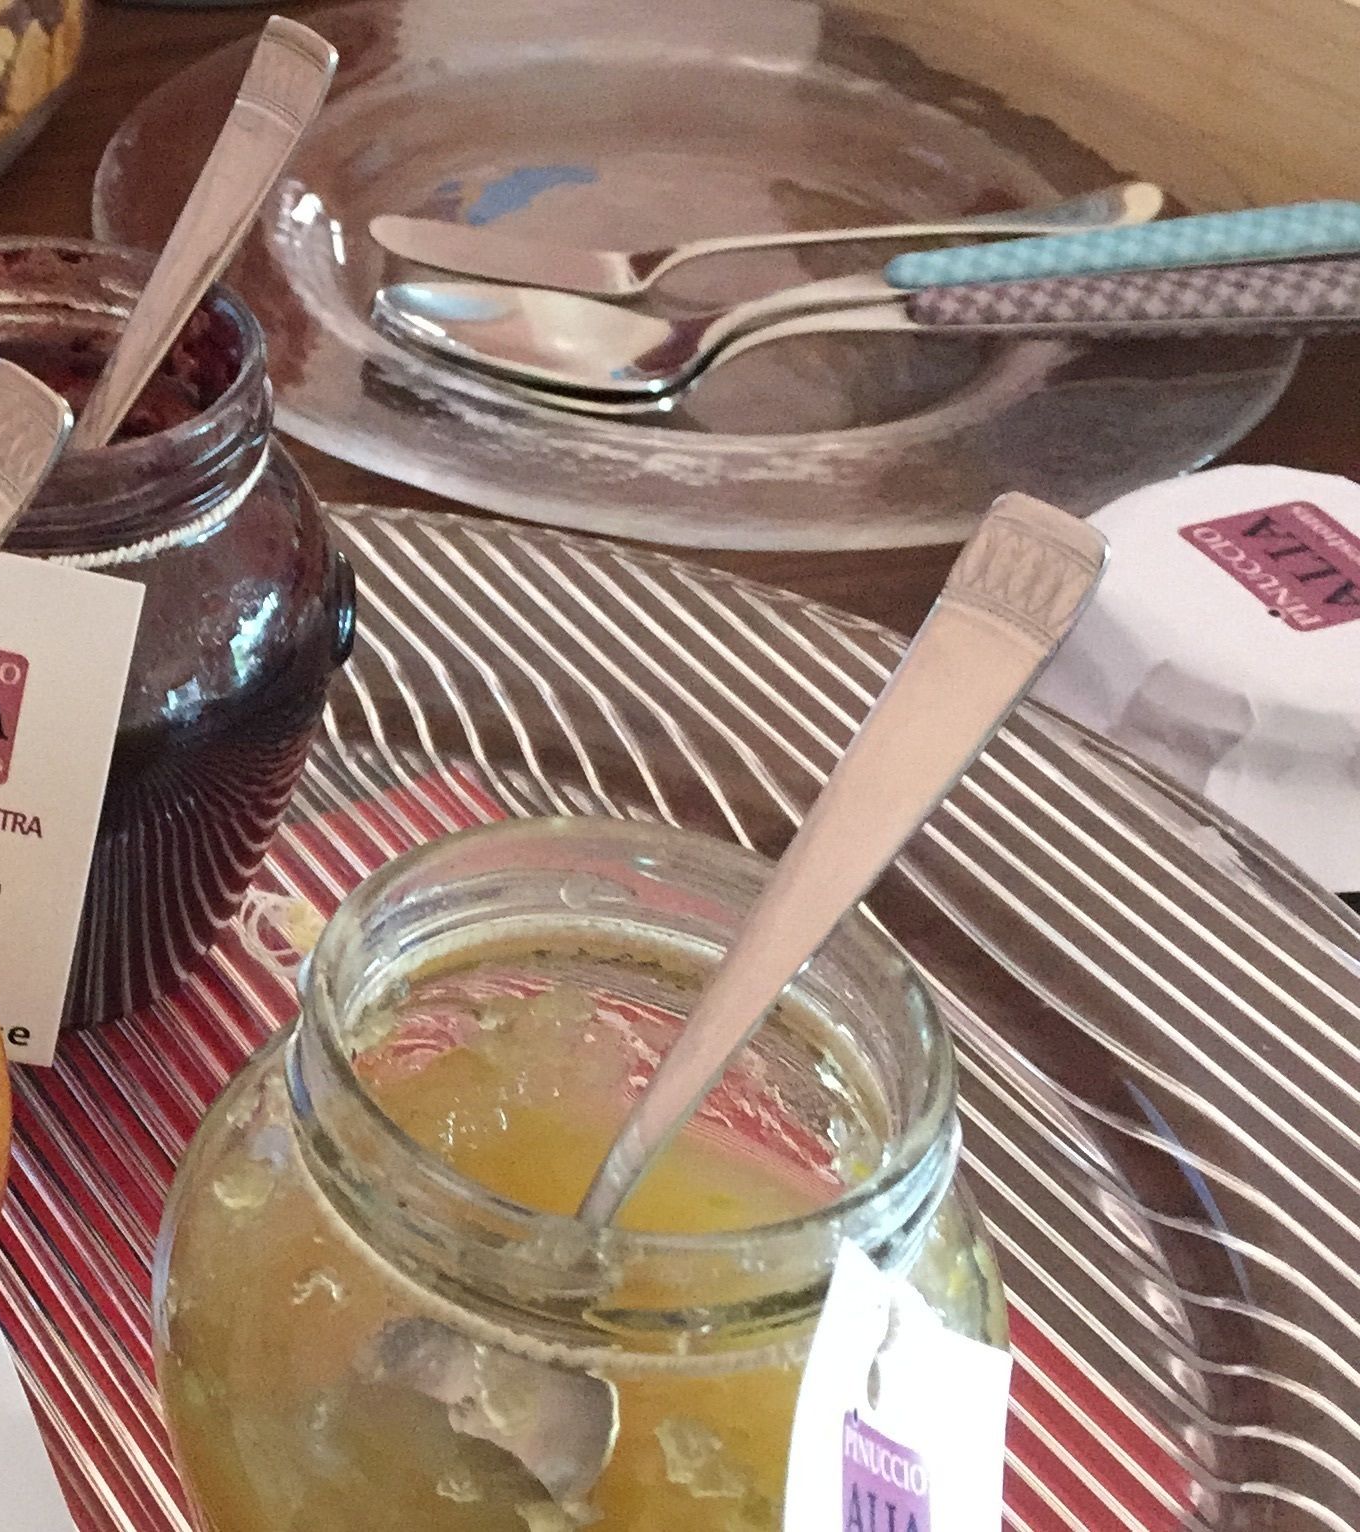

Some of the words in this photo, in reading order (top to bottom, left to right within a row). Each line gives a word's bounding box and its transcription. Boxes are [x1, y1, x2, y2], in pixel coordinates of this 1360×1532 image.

[1193, 526, 1321, 625] PINUCCIO
[1242, 515, 1360, 606] ALIA
[844, 1424, 928, 1496] PINUCCIO
